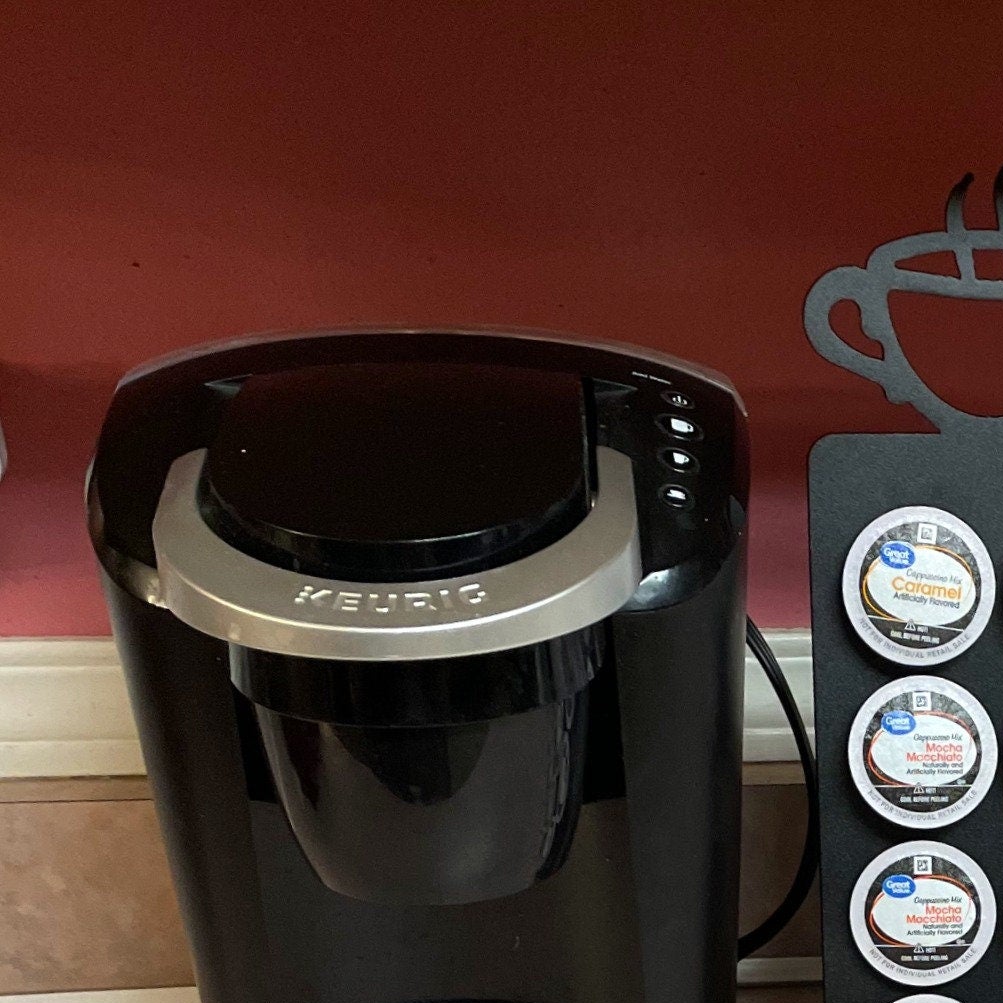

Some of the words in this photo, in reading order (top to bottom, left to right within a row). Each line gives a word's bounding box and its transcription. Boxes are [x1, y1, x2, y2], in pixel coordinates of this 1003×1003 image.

[891, 576, 962, 599] Caramel
[294, 583, 487, 613] KEURIG
[927, 743, 962, 751] Mocha
[907, 753, 962, 761] Macchiato
[927, 905, 962, 913] Mocha
[908, 914, 962, 922] Macchiato
